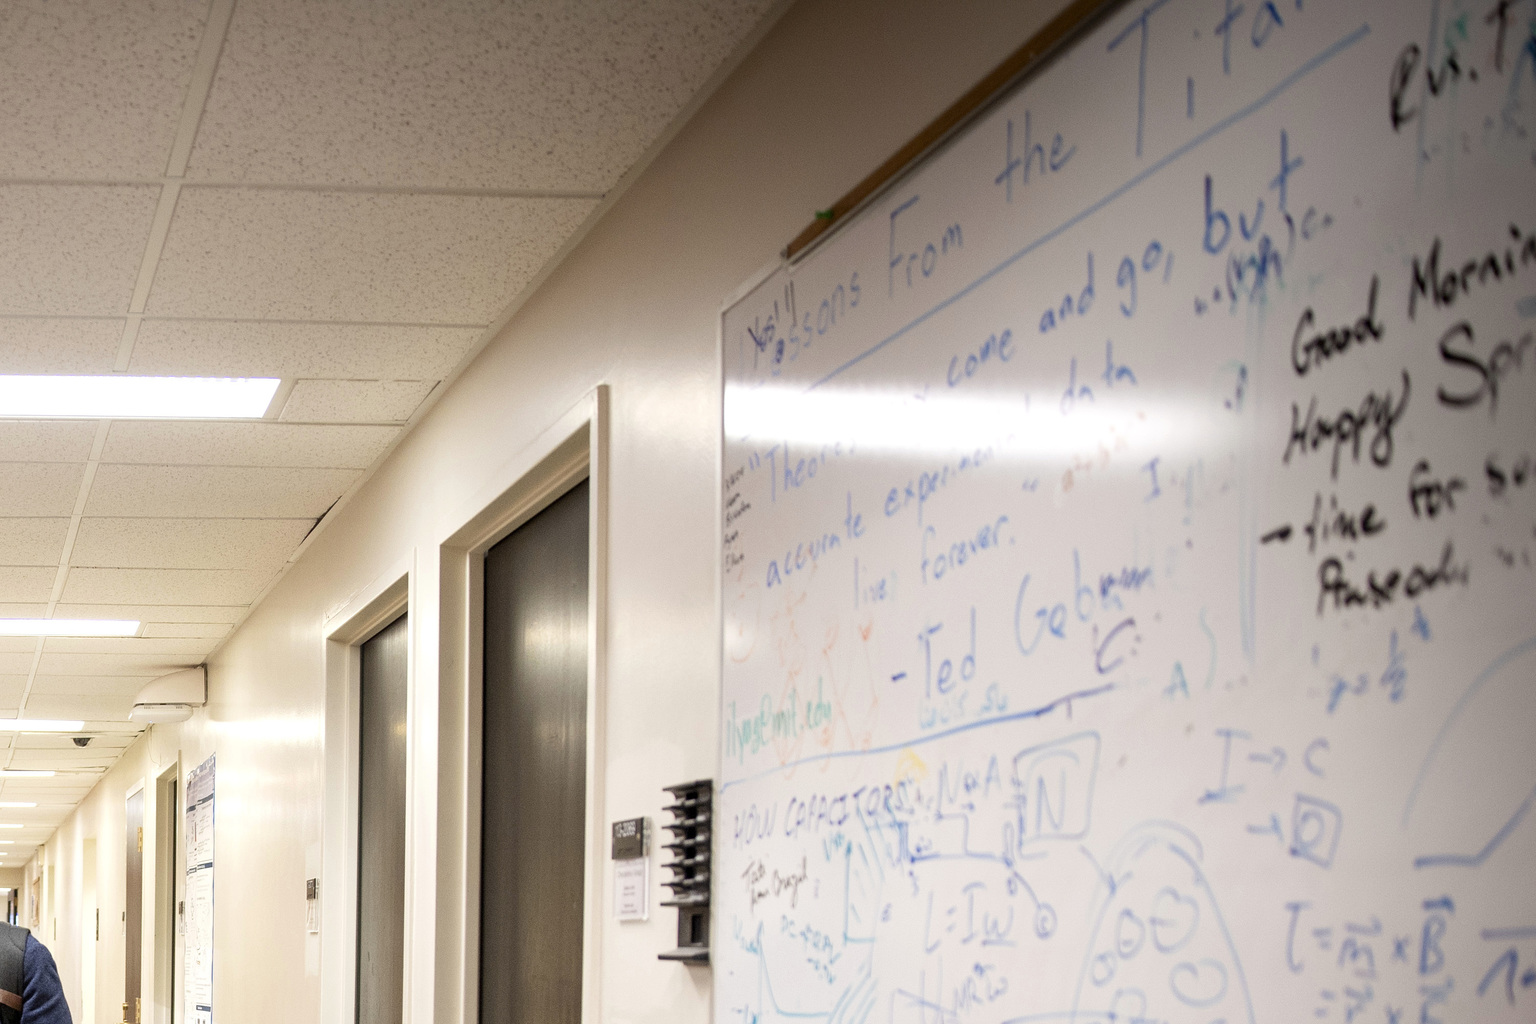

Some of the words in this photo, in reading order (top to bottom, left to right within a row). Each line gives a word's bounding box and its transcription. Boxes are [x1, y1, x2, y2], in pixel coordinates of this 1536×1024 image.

[994, 109, 1077, 204] the
[946, 328, 1015, 388] come
[1038, 250, 1096, 334] and
[1202, 129, 1305, 255] but
[1292, 273, 1385, 377] Good
[1282, 367, 1412, 482] Happy
